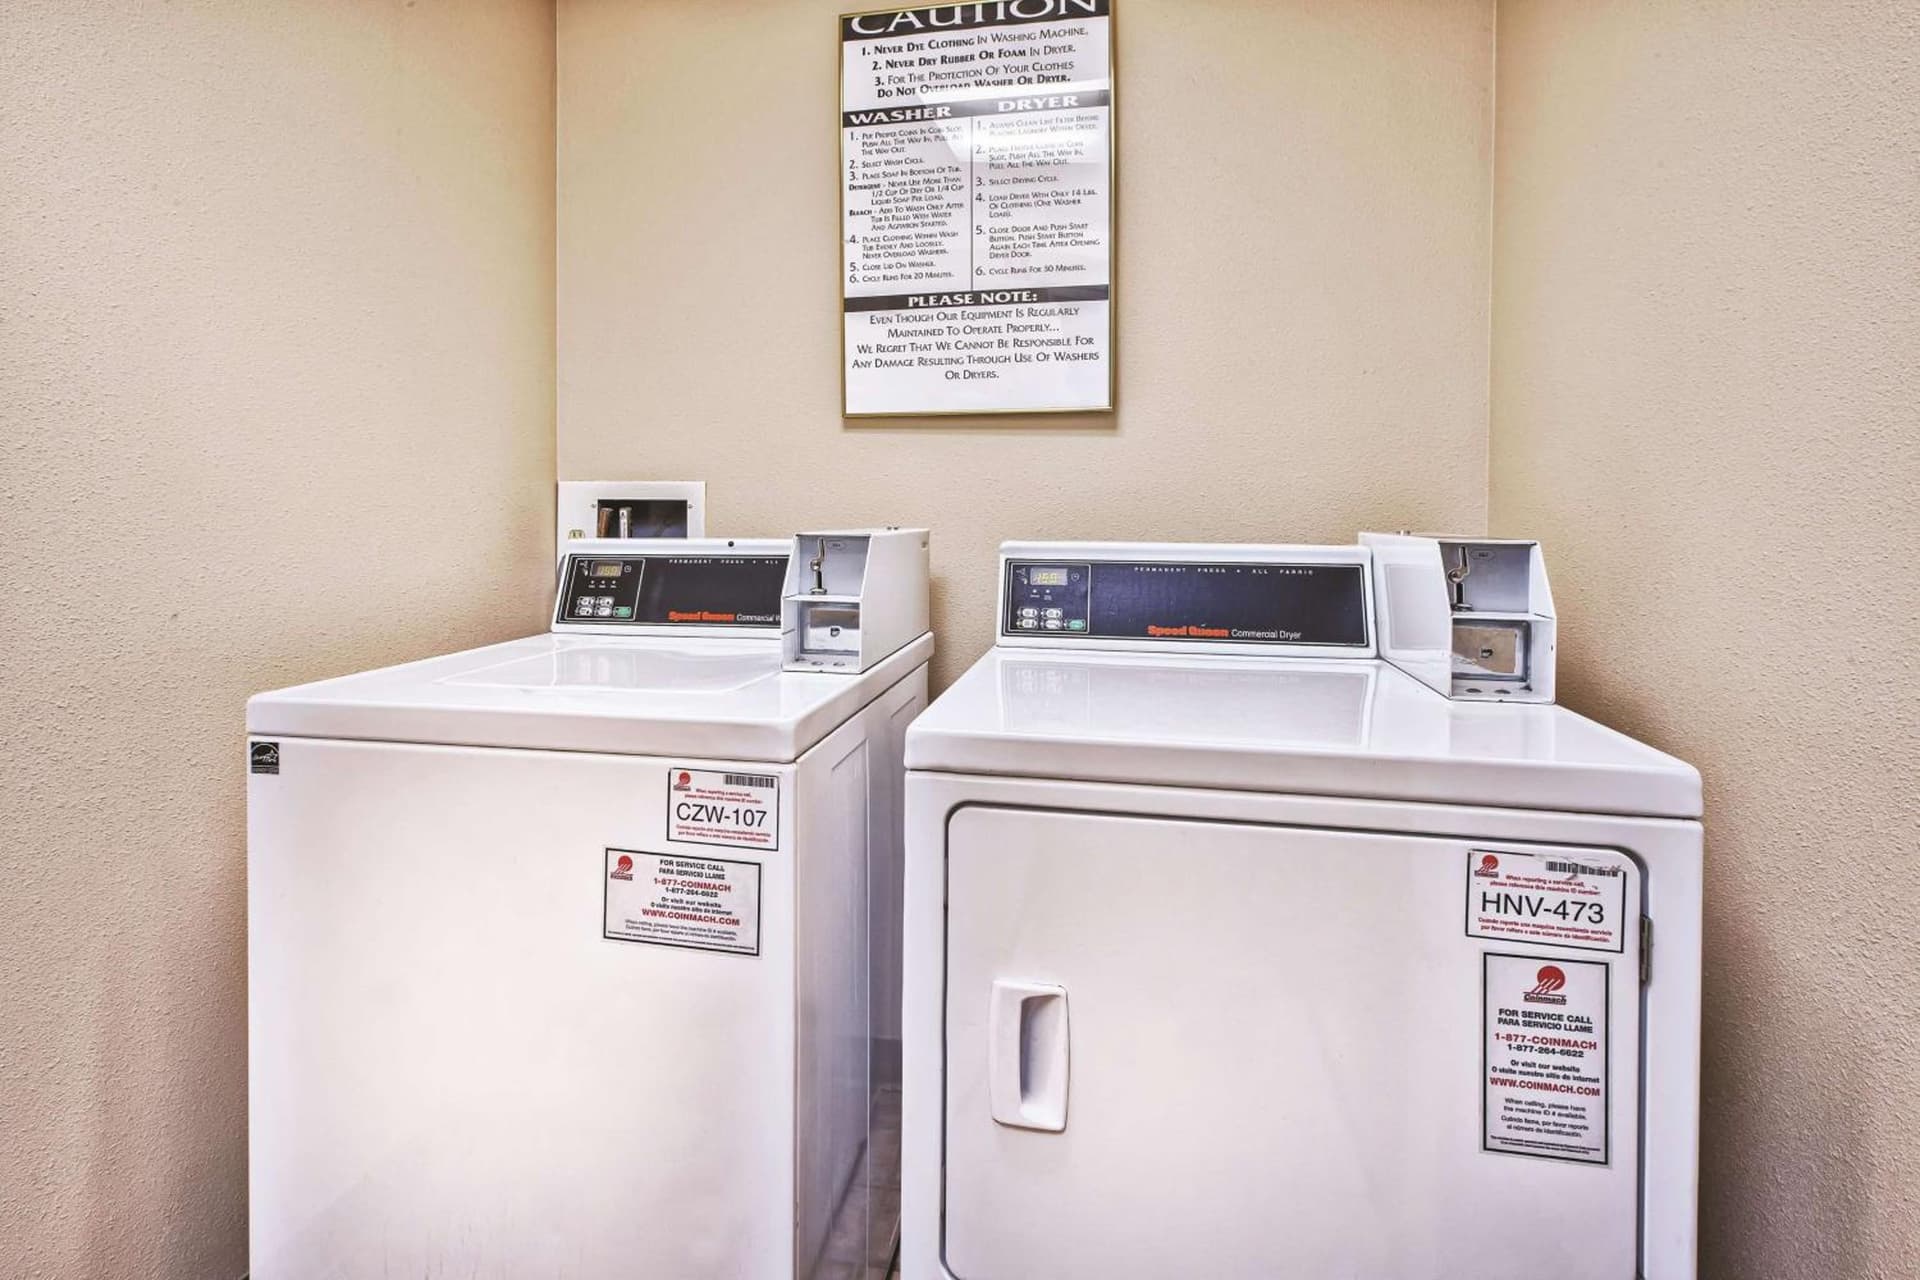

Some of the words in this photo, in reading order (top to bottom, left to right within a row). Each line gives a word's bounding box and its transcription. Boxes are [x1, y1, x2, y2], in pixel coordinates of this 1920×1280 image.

[862, 47, 870, 56] 1.
[872, 61, 882, 70] 2.
[875, 76, 884, 86] 3.
[998, 96, 1078, 112] DRYER
[850, 105, 951, 124] WASHER
[850, 131, 858, 140] 1.
[976, 146, 985, 154] 2.
[850, 160, 858, 169] 2.
[849, 172, 858, 180] 3.
[976, 177, 985, 186] 3.
[975, 193, 985, 201] 4.
[975, 225, 985, 235] 5.
[850, 235, 859, 243] 4.
[849, 262, 859, 271] 5.
[975, 266, 985, 275] 6.
[849, 274, 859, 283] 6.
[908, 294, 974, 307] PLEASE
[981, 290, 1037, 304] NOTE:
[1231, 629, 1277, 638] Commercial
[1279, 630, 1301, 640] Dryer
[676, 802, 767, 827] CZW-107
[660, 859, 673, 867] FOR
[676, 861, 705, 870] SERVICE
[707, 863, 725, 872] CALL
[654, 878, 731, 892] 1-877-COINMACH
[1482, 891, 1604, 924] HNV-473
[642, 909, 740, 926] WWW.COINMACH.COM
[1499, 1008, 1519, 1017] FOR
[1521, 1010, 1564, 1021] SERVICE
[1567, 1015, 1592, 1024] CALL
[1498, 1017, 1520, 1026] PARA
[1522, 1020, 1562, 1030] SERVICIO
[1564, 1024, 1593, 1033] LLAME
[1495, 1032, 1597, 1050] 1-877-COINMACH
[1508, 1044, 1584, 1058] 1-877-264-6622
[1490, 1077, 1600, 1096] WWW.COINMACH.COM
